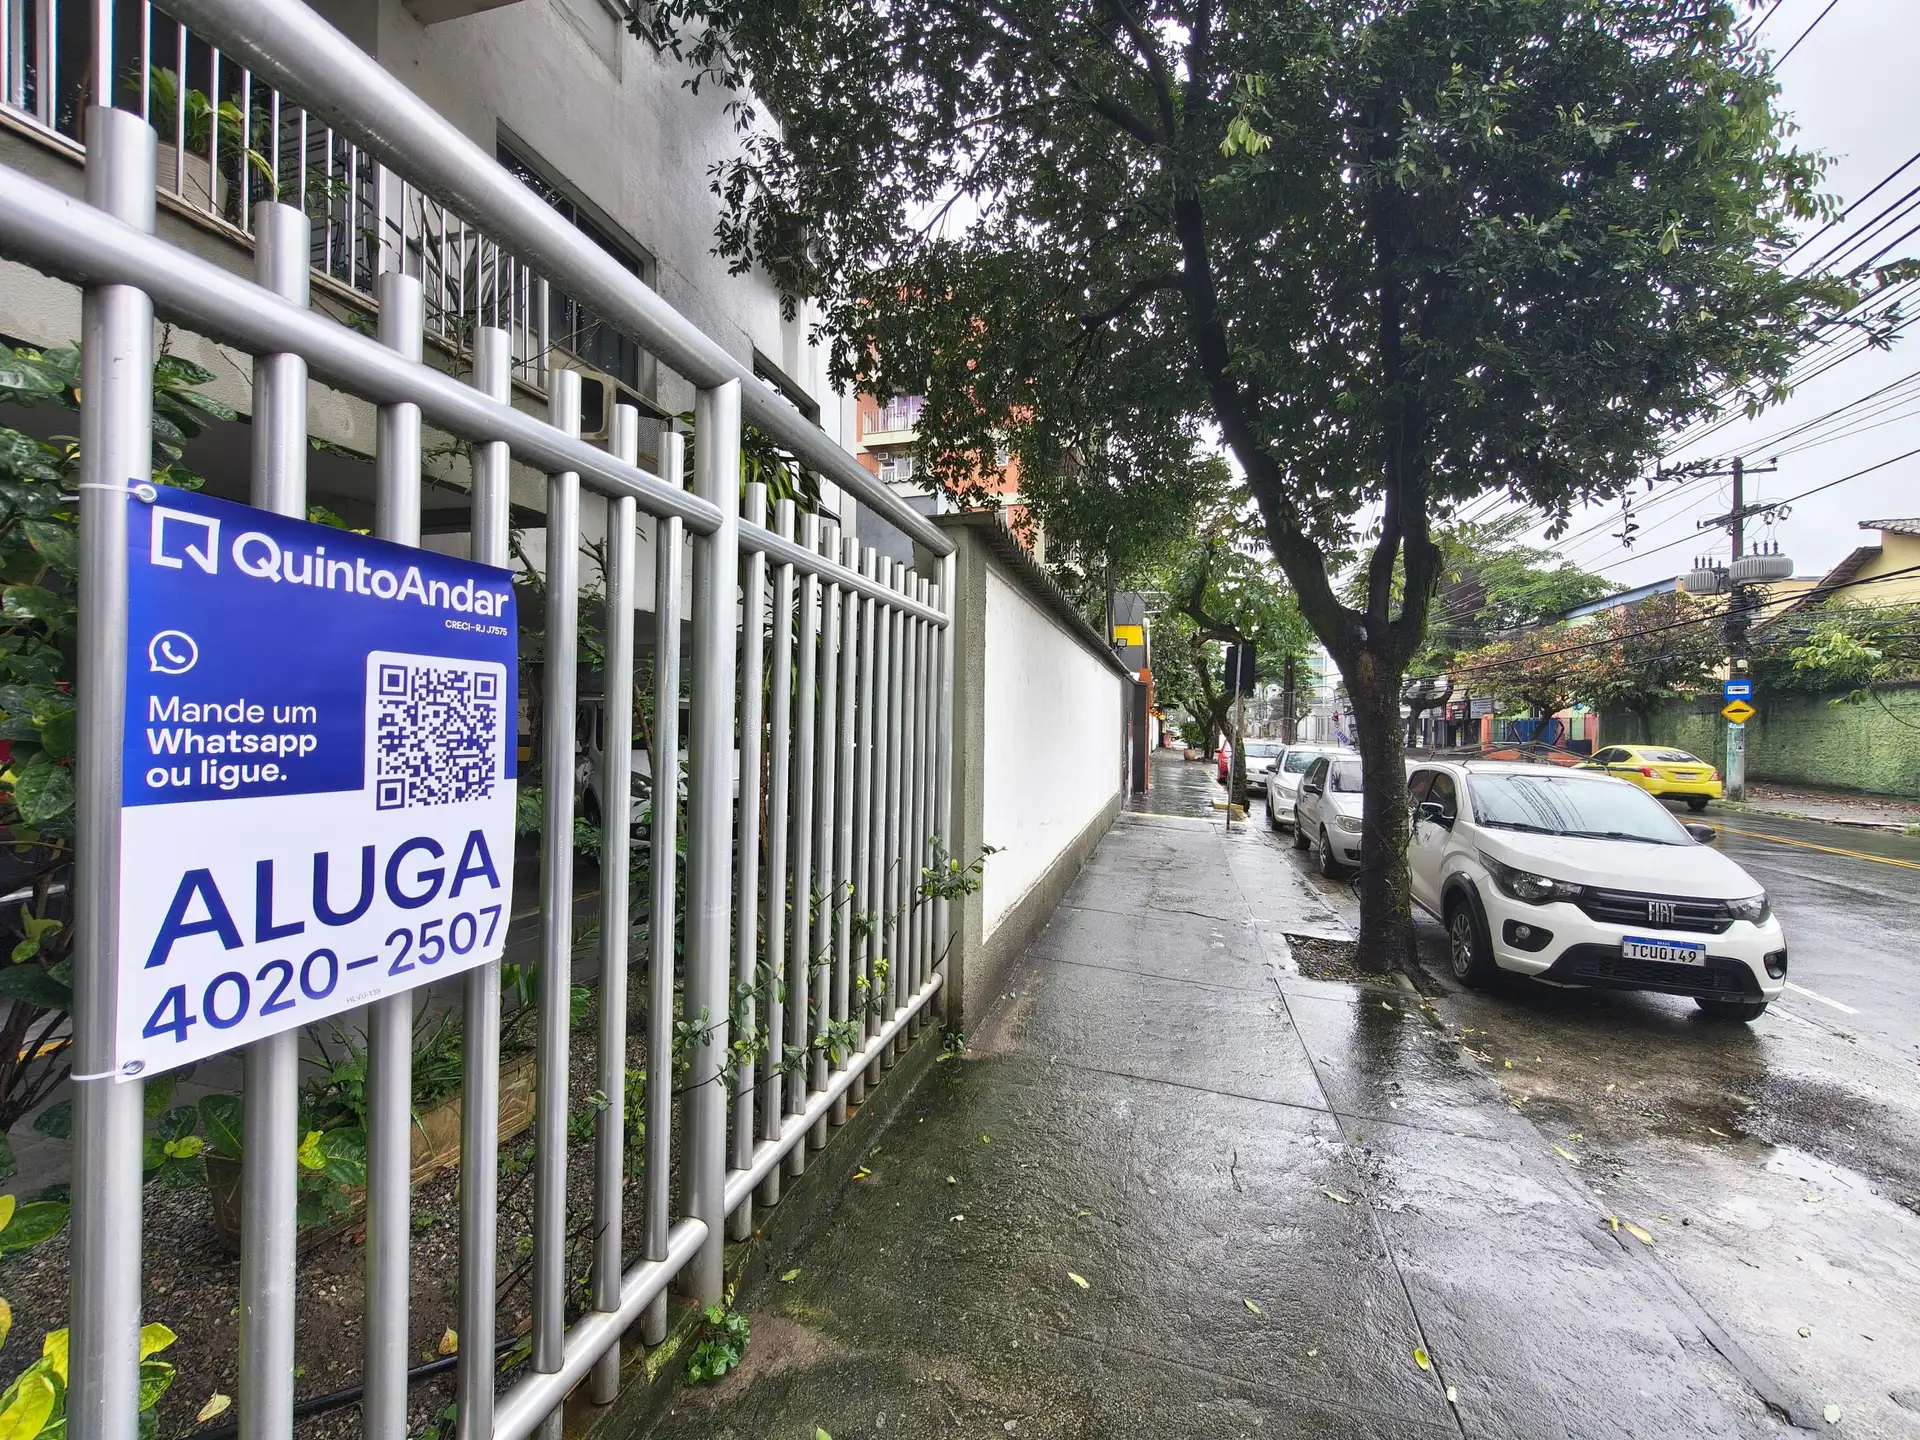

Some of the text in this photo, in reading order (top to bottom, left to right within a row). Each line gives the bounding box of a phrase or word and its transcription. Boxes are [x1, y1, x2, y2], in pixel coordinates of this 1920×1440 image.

[231, 531, 509, 617] QuintoAndar
[445, 619, 508, 636] CRECI-RJ J7575
[149, 696, 317, 724] Mande um
[146, 728, 318, 757] Whatsapp
[145, 759, 288, 790] ou ligue.
[143, 829, 501, 970] ALUGA
[1648, 901, 1677, 923] FIAT
[142, 903, 502, 1044] 4020-2507
